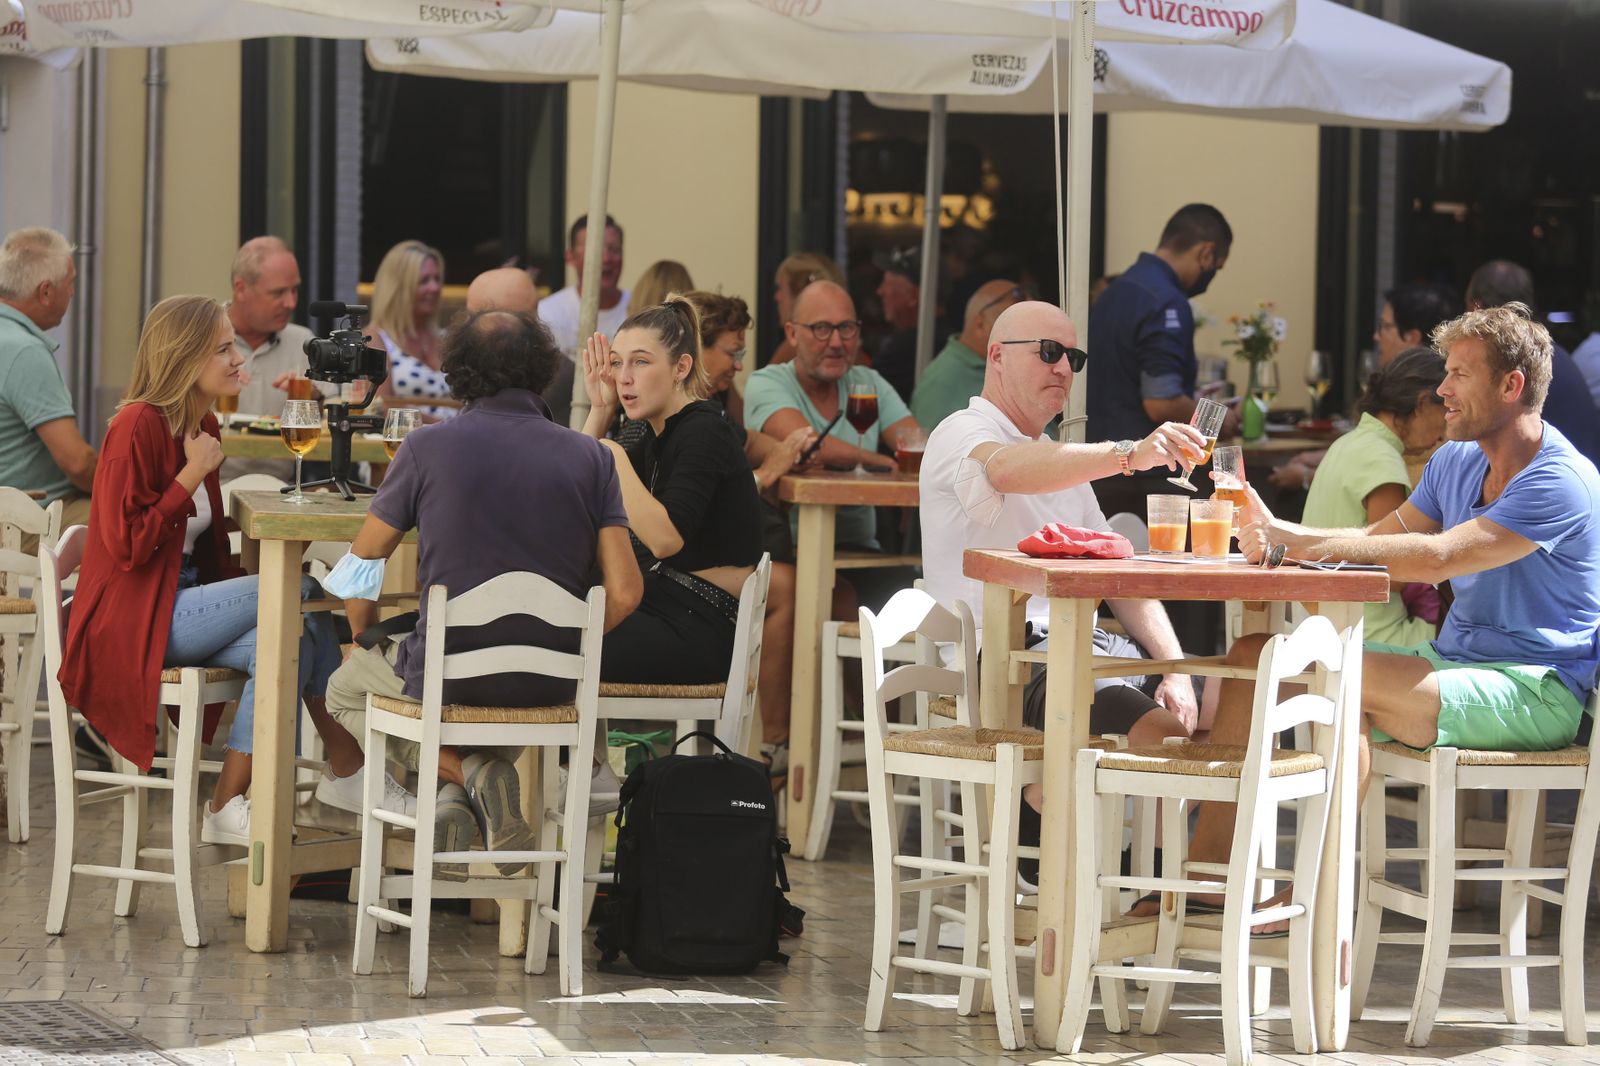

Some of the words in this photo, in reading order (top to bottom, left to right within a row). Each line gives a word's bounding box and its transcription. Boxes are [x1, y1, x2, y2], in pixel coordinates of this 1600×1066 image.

[419, 4, 509, 25] ESPECIAL
[971, 54, 1027, 71] CERVEZAS
[738, 800, 766, 810] Profoto
